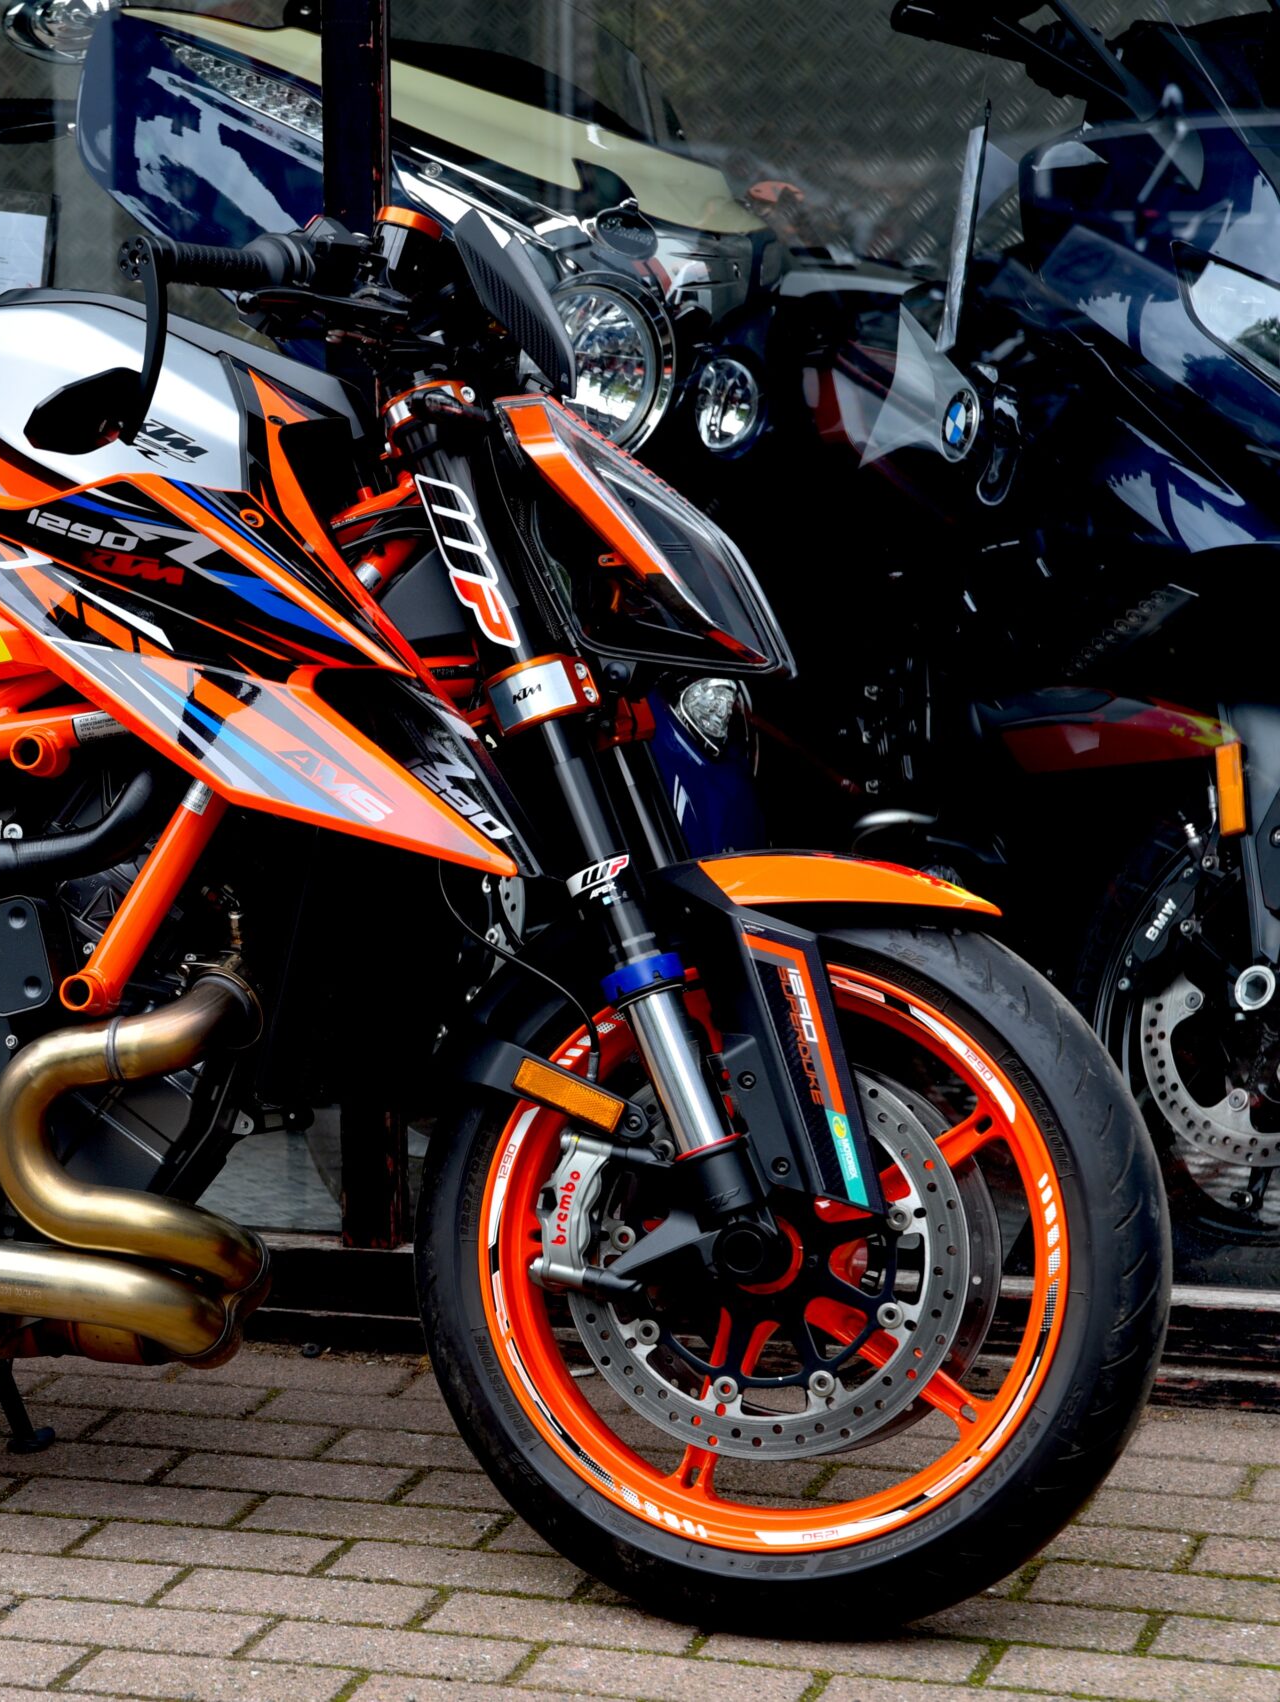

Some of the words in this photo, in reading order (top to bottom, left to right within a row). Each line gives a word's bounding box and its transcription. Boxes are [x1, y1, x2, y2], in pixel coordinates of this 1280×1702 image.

[26, 508, 140, 552] 1290
[81, 548, 185, 586] KTM
[414, 473, 521, 649] WP
[513, 684, 542, 705] KTM
[276, 750, 395, 823] AMS
[403, 757, 514, 840] 1290
[566, 854, 630, 898] WP
[589, 881, 618, 901] APEX
[1145, 898, 1177, 942] BMW
[786, 967, 819, 1043] 1290
[963, 1049, 994, 1082] 1290
[497, 1143, 518, 1180] 1290
[550, 1170, 581, 1246] brembo
[473, 1334, 538, 1443] BRIDGESTONE
[800, 1528, 841, 1544] 1290
